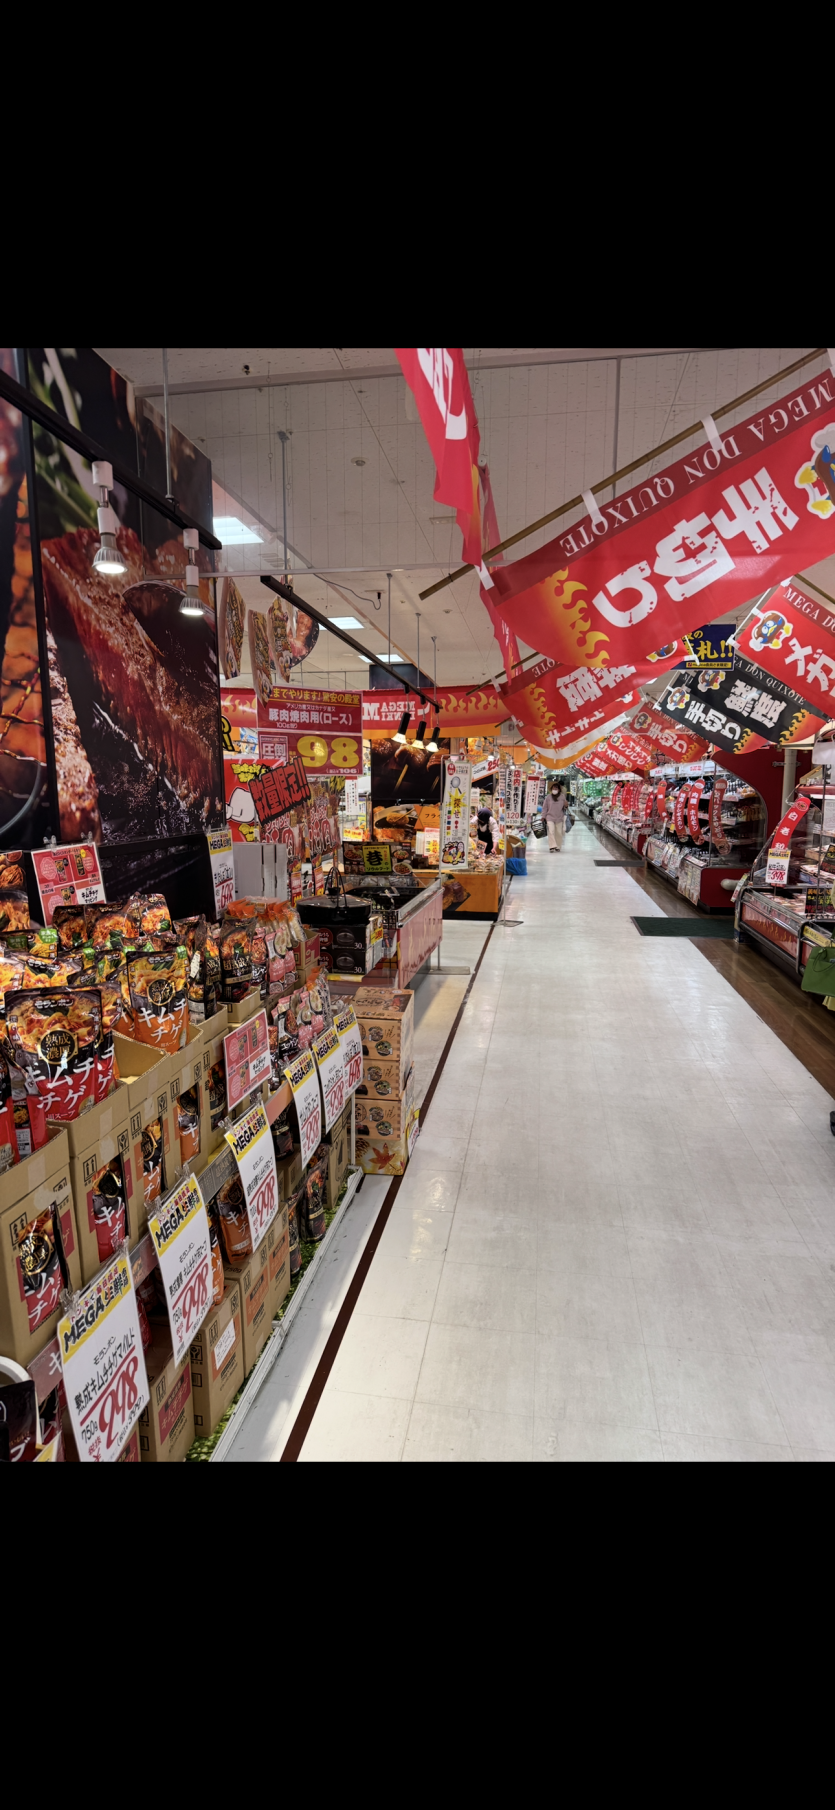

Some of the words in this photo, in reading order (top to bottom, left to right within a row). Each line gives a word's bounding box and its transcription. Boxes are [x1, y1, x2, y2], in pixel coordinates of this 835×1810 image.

[748, 378, 835, 443] MEGA
[682, 434, 743, 485] DON
[559, 476, 676, 558] QUIXOTE
[592, 466, 800, 628] 手切り
[783, 587, 820, 620] MEGA
[745, 661, 766, 681] DON
[766, 677, 807, 706] QUIXOTE
[784, 637, 835, 698] メガ
[684, 700, 741, 741] 手切り
[297, 736, 360, 768] 98
[249, 756, 310, 822] 数量限定!!
[138, 998, 187, 1028] キムチ
[150, 1020, 183, 1044] チゲ
[25, 1057, 95, 1089] キムチ
[36, 1085, 87, 1112] チゲ
[81, 1420, 98, 1444] 750g
